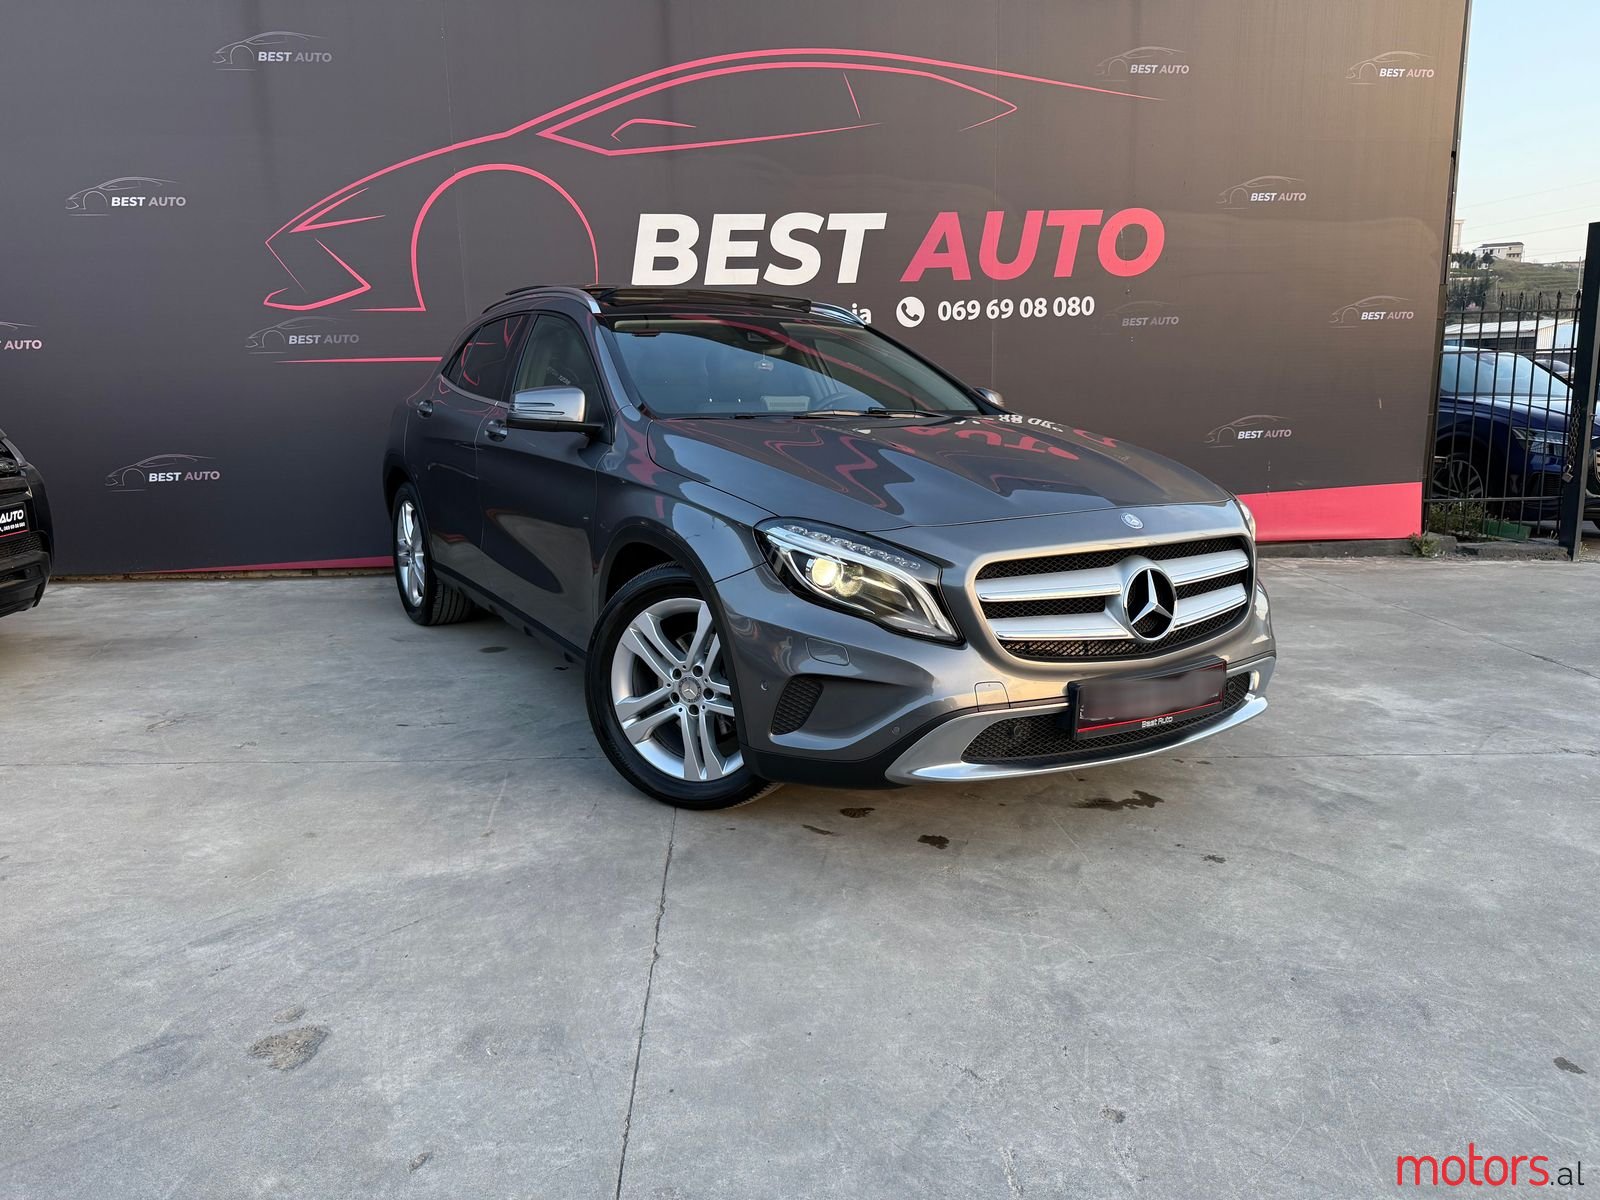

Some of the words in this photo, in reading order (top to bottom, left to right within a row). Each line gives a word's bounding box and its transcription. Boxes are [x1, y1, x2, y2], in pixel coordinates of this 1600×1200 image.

[257, 51, 292, 62] BEST
[295, 52, 332, 63] AUTO
[1130, 65, 1158, 74] BEST
[1159, 65, 1190, 74] AUTO
[1379, 68, 1406, 78] BEST
[1406, 69, 1435, 78] AUTO
[111, 197, 146, 207] BEST
[148, 197, 187, 207] AUTO
[1250, 193, 1277, 201] BEST
[1278, 193, 1307, 201] AUTO
[631, 212, 887, 287] BEST
[900, 208, 1166, 283] AUTO
[937, 300, 981, 322] 069
[985, 298, 1014, 320] 69
[1019, 297, 1048, 318] 08
[1052, 295, 1095, 317] 080
[1121, 317, 1149, 326] BEST
[1150, 316, 1180, 325] AUTO
[1360, 312, 1387, 320] BEST
[1387, 312, 1414, 320] AUTO
[288, 335, 321, 345] BEST
[323, 334, 359, 344] AUTO
[3, 340, 42, 350] AUTO
[1237, 430, 1264, 439] BEST
[1264, 429, 1292, 438] AUTO
[148, 472, 182, 482] BEST
[184, 471, 220, 481] AUTO
[0, 510, 24, 524] AUTO
